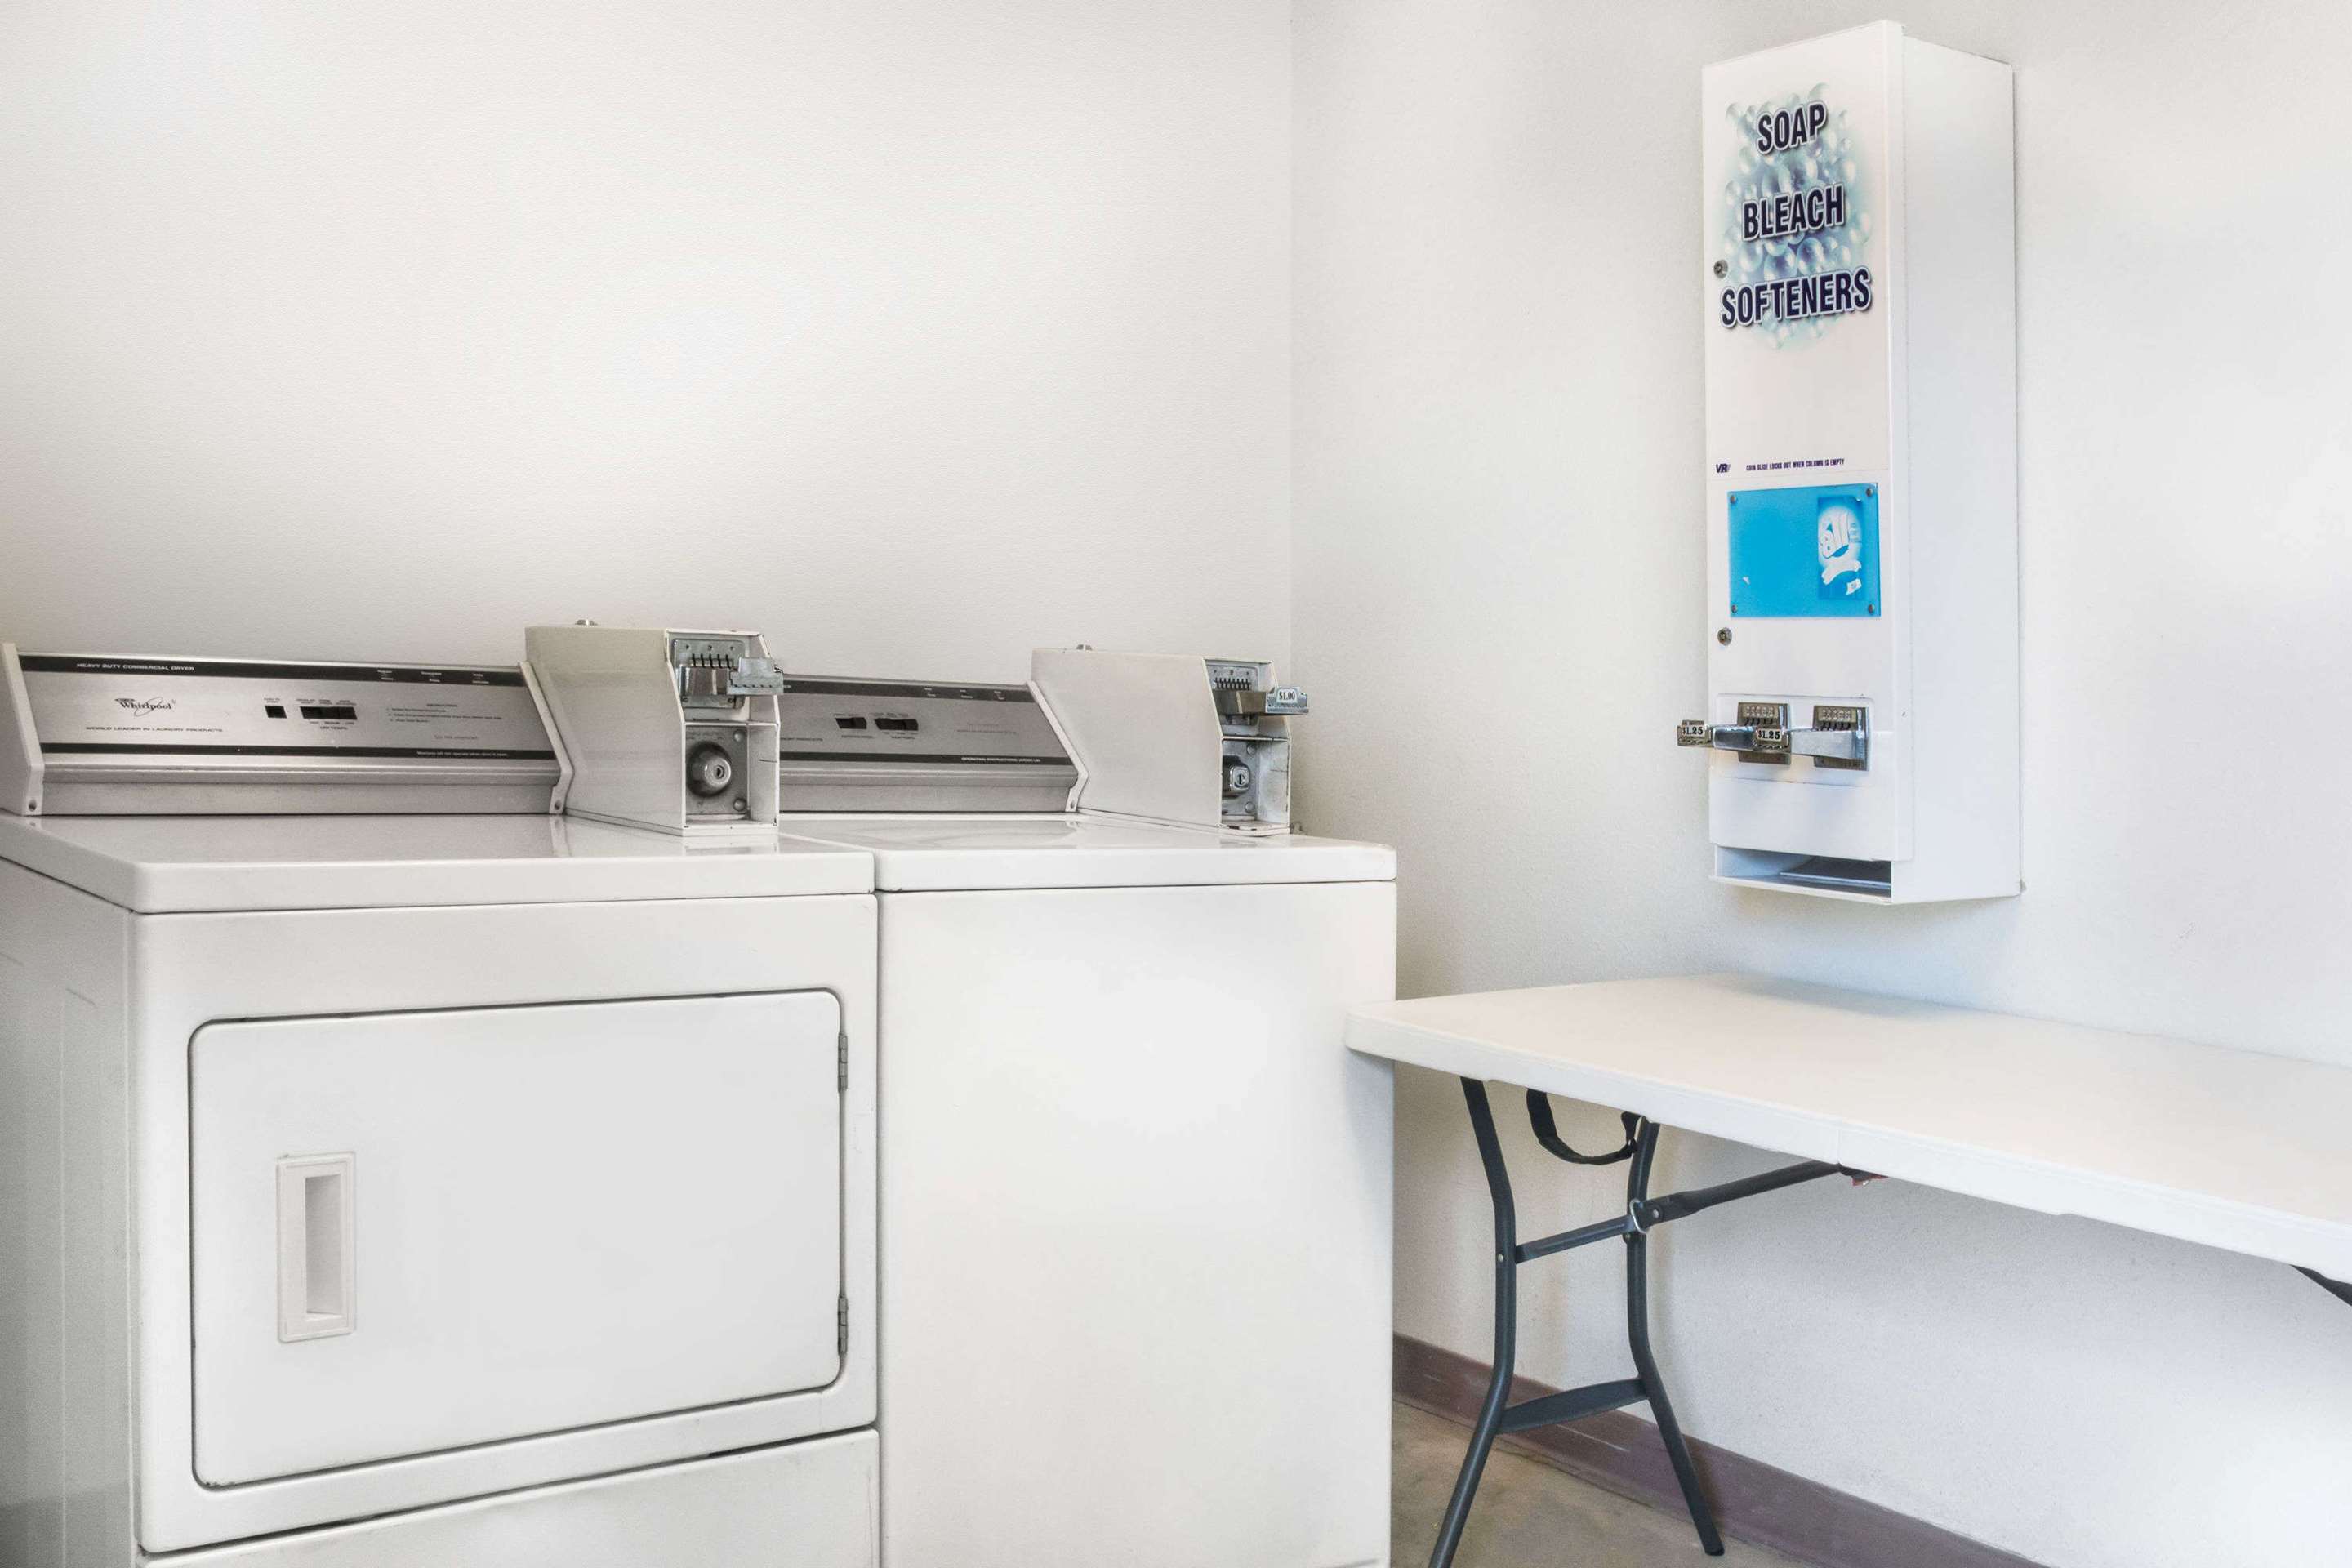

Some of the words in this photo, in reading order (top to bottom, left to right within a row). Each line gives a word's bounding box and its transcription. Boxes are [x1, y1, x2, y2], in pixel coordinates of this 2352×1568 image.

[1757, 101, 1826, 154] SOAP
[1743, 184, 1845, 242] BLEACH
[1721, 267, 1872, 327] SOFTENERS
[115, 697, 172, 714] Whirlpool
[1279, 691, 1295, 700] $1.00
[1757, 731, 1780, 740] $1.25
